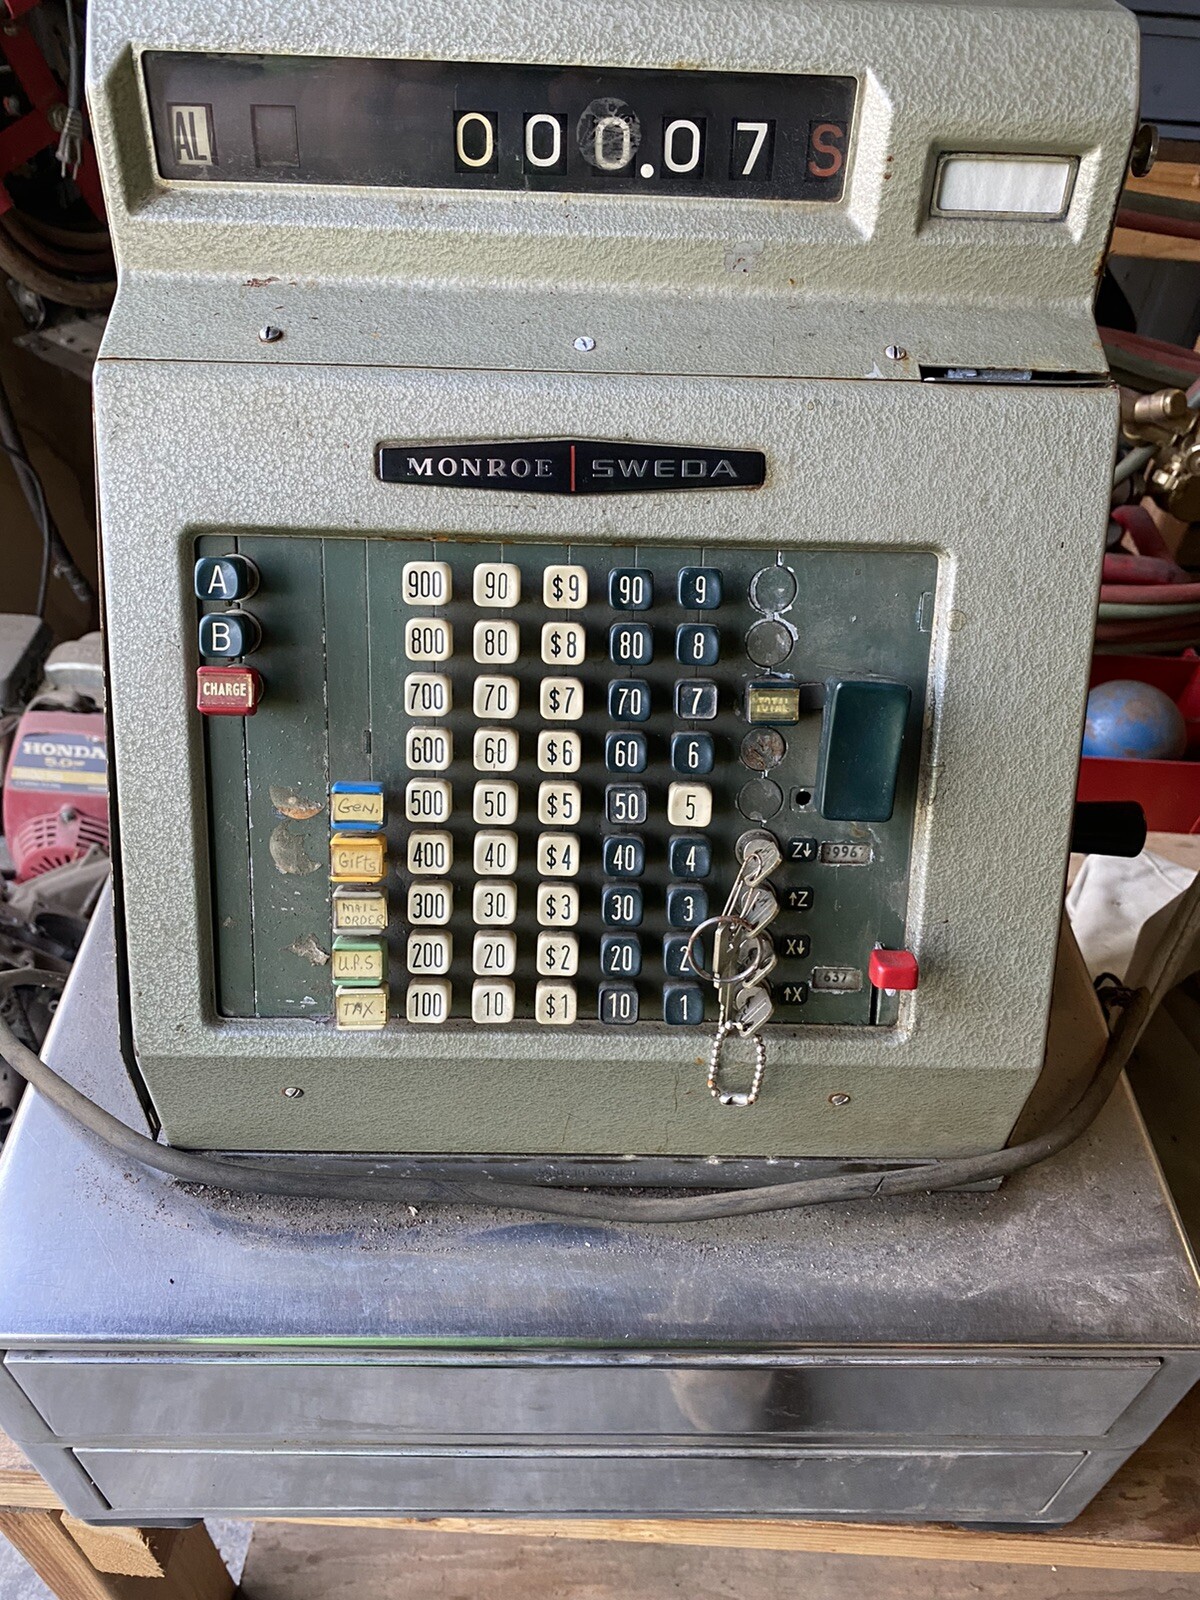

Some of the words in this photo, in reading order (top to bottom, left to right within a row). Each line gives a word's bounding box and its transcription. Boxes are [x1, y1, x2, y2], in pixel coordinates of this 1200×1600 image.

[406, 457, 553, 477] MONROE
[591, 458, 738, 478] SWEDA
[207, 565, 228, 595] A
[408, 570, 443, 599] 900
[485, 572, 508, 600] 90
[552, 574, 580, 602] $9
[619, 575, 644, 605] 90
[694, 575, 707, 604] 9
[211, 622, 230, 652] B
[411, 627, 445, 655] 800
[485, 629, 508, 657] 80
[550, 630, 578, 659] $8
[619, 631, 644, 660] 80
[693, 632, 705, 660] 8
[203, 681, 247, 697] CHARGE
[410, 683, 443, 711] 700
[484, 684, 508, 711] 70
[549, 686, 576, 714] $7
[617, 688, 642, 716] 70
[690, 687, 703, 715] 7
[23, 741, 106, 760] HONDA
[411, 737, 444, 764] 600
[485, 737, 508, 765] 60
[546, 739, 574, 766] $6
[615, 740, 639, 768] 60
[688, 741, 700, 769] 6
[411, 790, 444, 816] 500
[485, 791, 507, 818] 50
[546, 792, 573, 819] $5
[615, 793, 639, 821] 50
[685, 794, 697, 821] 5
[413, 842, 445, 868] 400
[485, 842, 507, 868] 40
[546, 844, 572, 871] $4
[613, 844, 635, 871] 40
[685, 846, 697, 873] 4
[791, 842, 803, 858] Z
[342, 902, 379, 913] MAIL
[413, 893, 444, 919] 300
[484, 892, 506, 919] 30
[546, 894, 572, 921] $3
[611, 895, 634, 921] 30
[683, 896, 694, 922] 3
[798, 891, 808, 907] Z
[344, 915, 385, 926] ORDER
[413, 942, 444, 968] 200
[484, 944, 505, 969] 20
[545, 944, 570, 971] $2
[610, 945, 632, 972] 20
[679, 945, 690, 972] 2
[787, 939, 797, 955] X
[412, 992, 442, 1018] 100
[483, 991, 504, 1017] 10
[545, 993, 569, 1019] $1
[608, 992, 630, 1019] 10
[680, 994, 688, 1021] 1
[792, 987, 802, 1002] X
